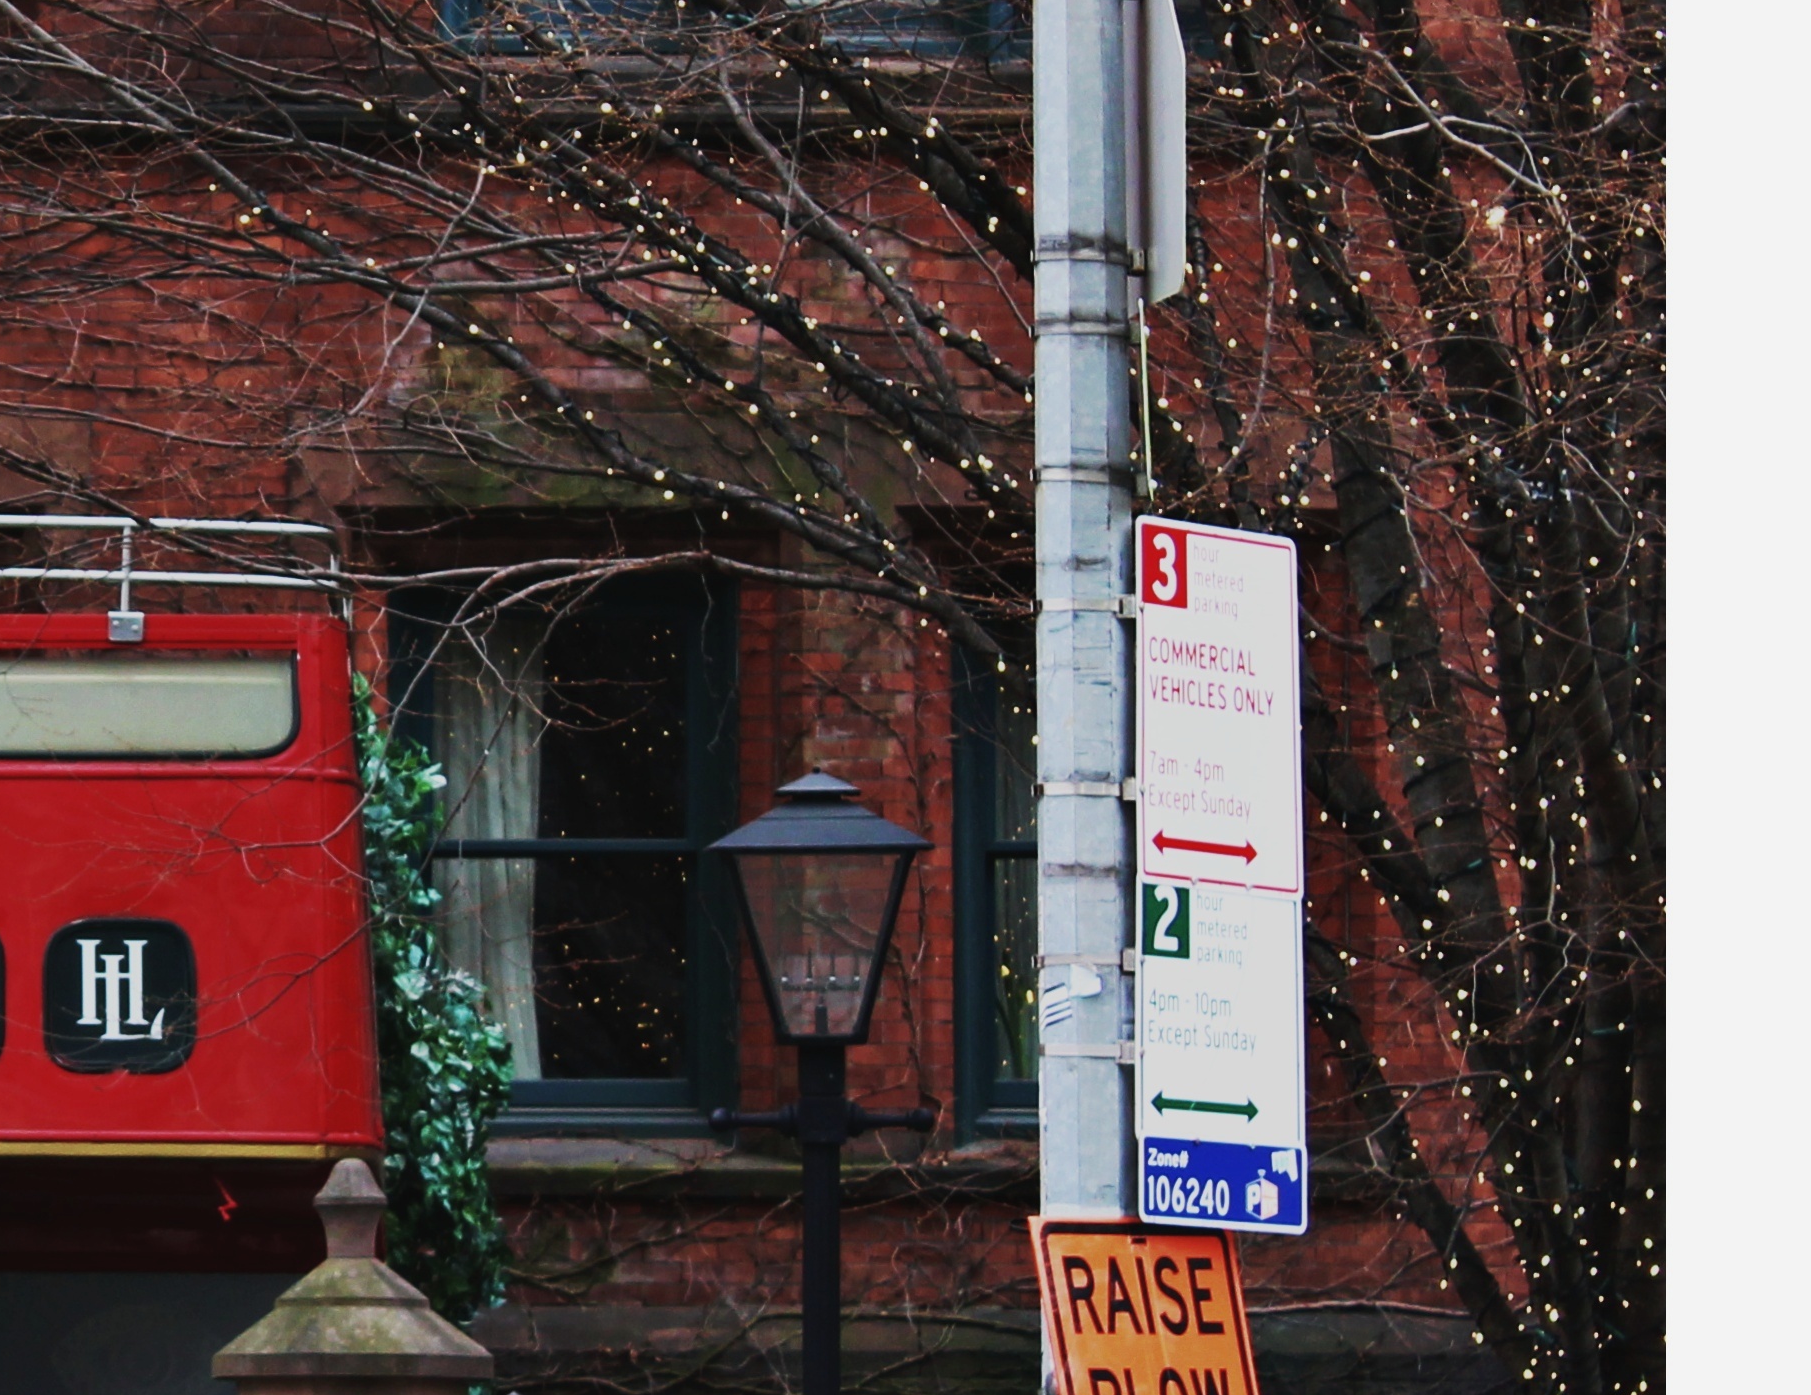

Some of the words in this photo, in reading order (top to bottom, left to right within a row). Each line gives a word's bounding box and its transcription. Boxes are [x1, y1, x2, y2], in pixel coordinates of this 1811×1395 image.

[1152, 532, 1178, 602] 3
[1193, 542, 1220, 563] hour
[1194, 569, 1245, 594] metered
[1194, 597, 1239, 621] parking
[1149, 635, 1256, 677] COMMERCIAL
[1149, 674, 1227, 711] VEHICLES
[1233, 686, 1275, 716] ONLY
[1149, 750, 1179, 776] 7am
[1193, 757, 1225, 783] 4pm
[1148, 783, 1196, 816] Except
[1201, 790, 1252, 823] Sunday
[1153, 884, 1179, 952] 2
[1196, 892, 1224, 912] hour
[1196, 920, 1248, 940] metered
[1196, 946, 1243, 969] parking
[1148, 988, 1180, 1014] 4pm
[1194, 991, 1232, 1019] 10pm
[1148, 1019, 1199, 1051] Except
[1204, 1024, 1257, 1057] Sunday
[1147, 1147, 1189, 1169] Zone#
[1147, 1174, 1230, 1217] 106240
[1062, 1255, 1226, 1336] RAISE
